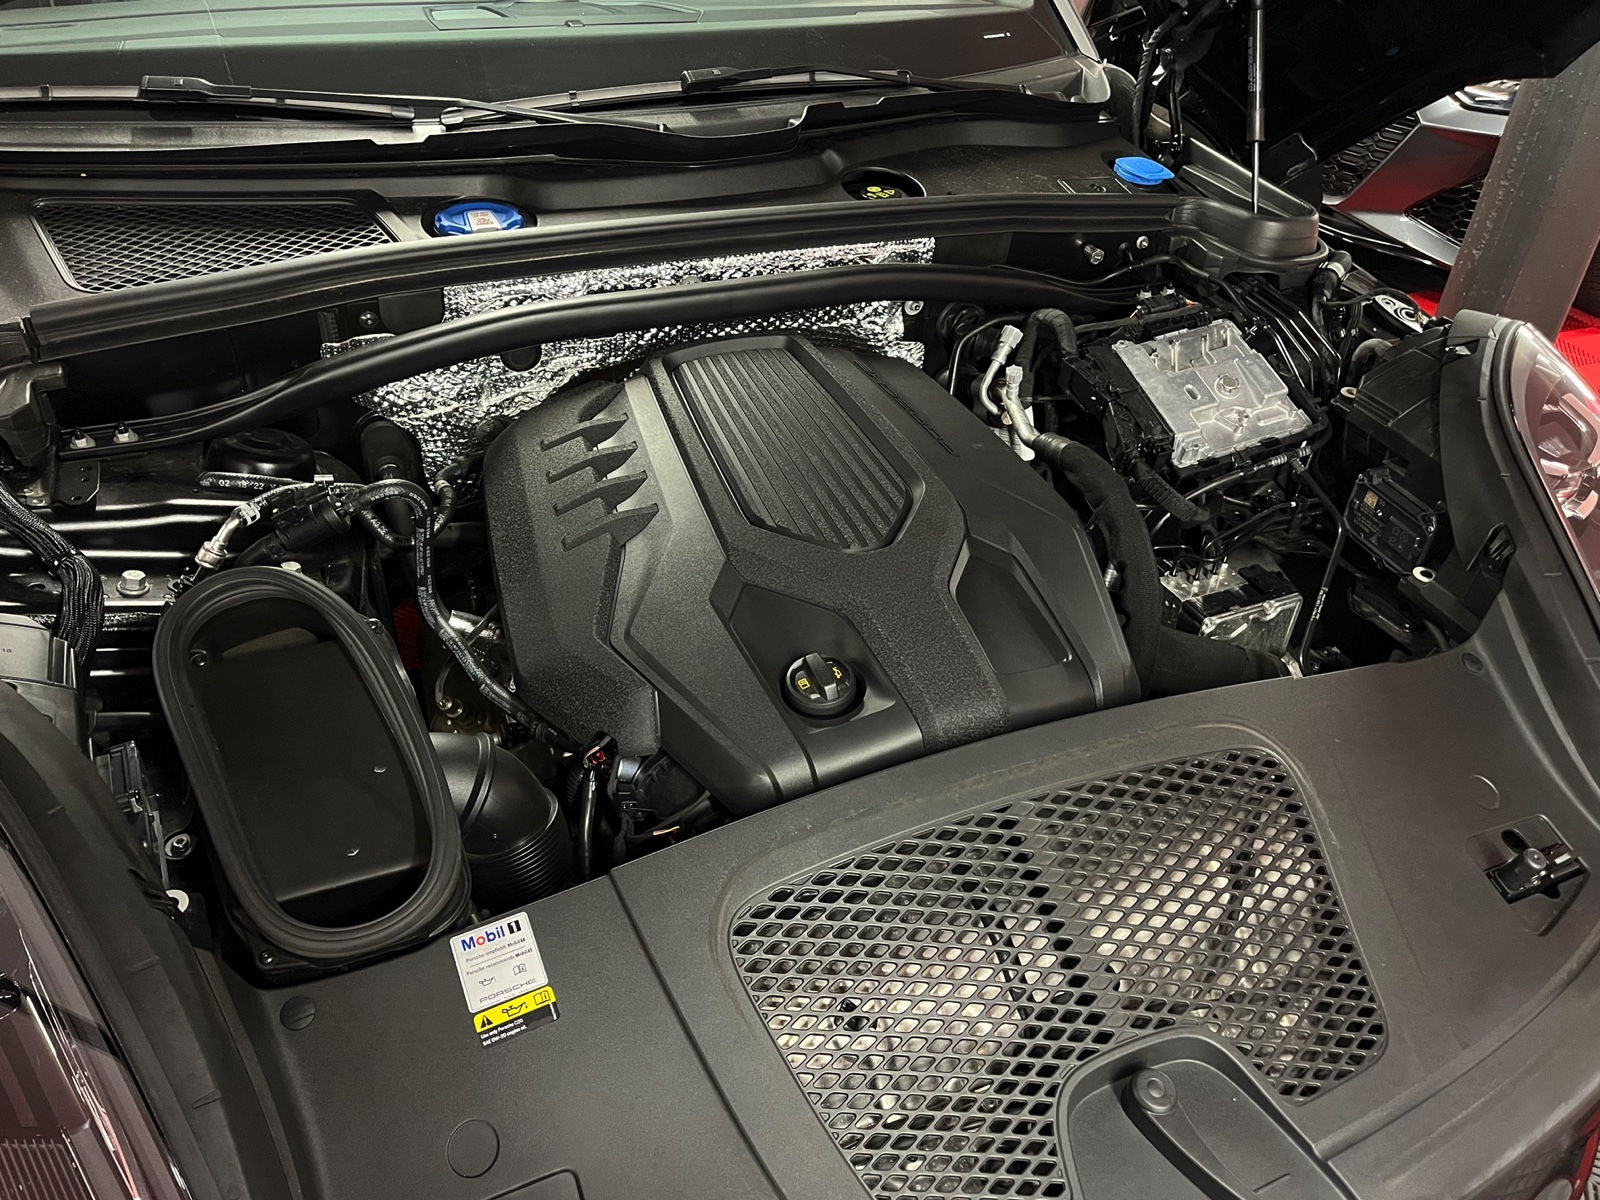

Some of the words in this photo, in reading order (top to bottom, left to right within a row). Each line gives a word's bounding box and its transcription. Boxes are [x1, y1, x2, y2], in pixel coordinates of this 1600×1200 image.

[461, 925, 505, 951] Mobil
[507, 920, 521, 934] 1
[466, 954, 485, 963] Porsche
[466, 967, 485, 976] Porsche
[486, 956, 514, 969] recommends
[480, 978, 536, 1003] PORSCHE
[498, 1023, 514, 1032] Porsche
